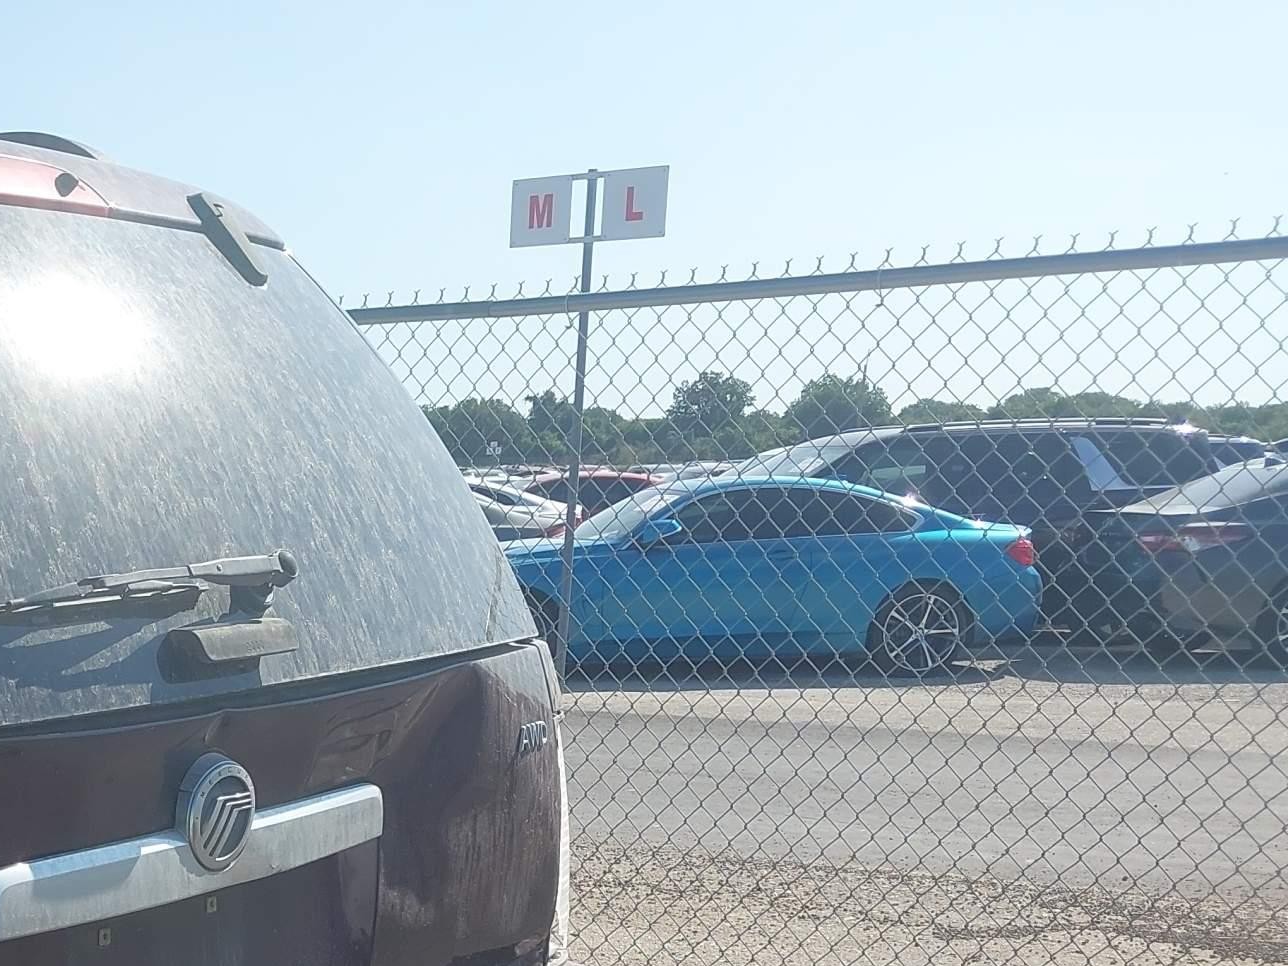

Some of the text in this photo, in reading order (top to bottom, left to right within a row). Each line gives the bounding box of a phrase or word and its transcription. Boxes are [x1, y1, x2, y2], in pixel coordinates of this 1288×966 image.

[528, 193, 554, 229] M
[624, 186, 644, 222] L
[518, 720, 548, 754] AWD
